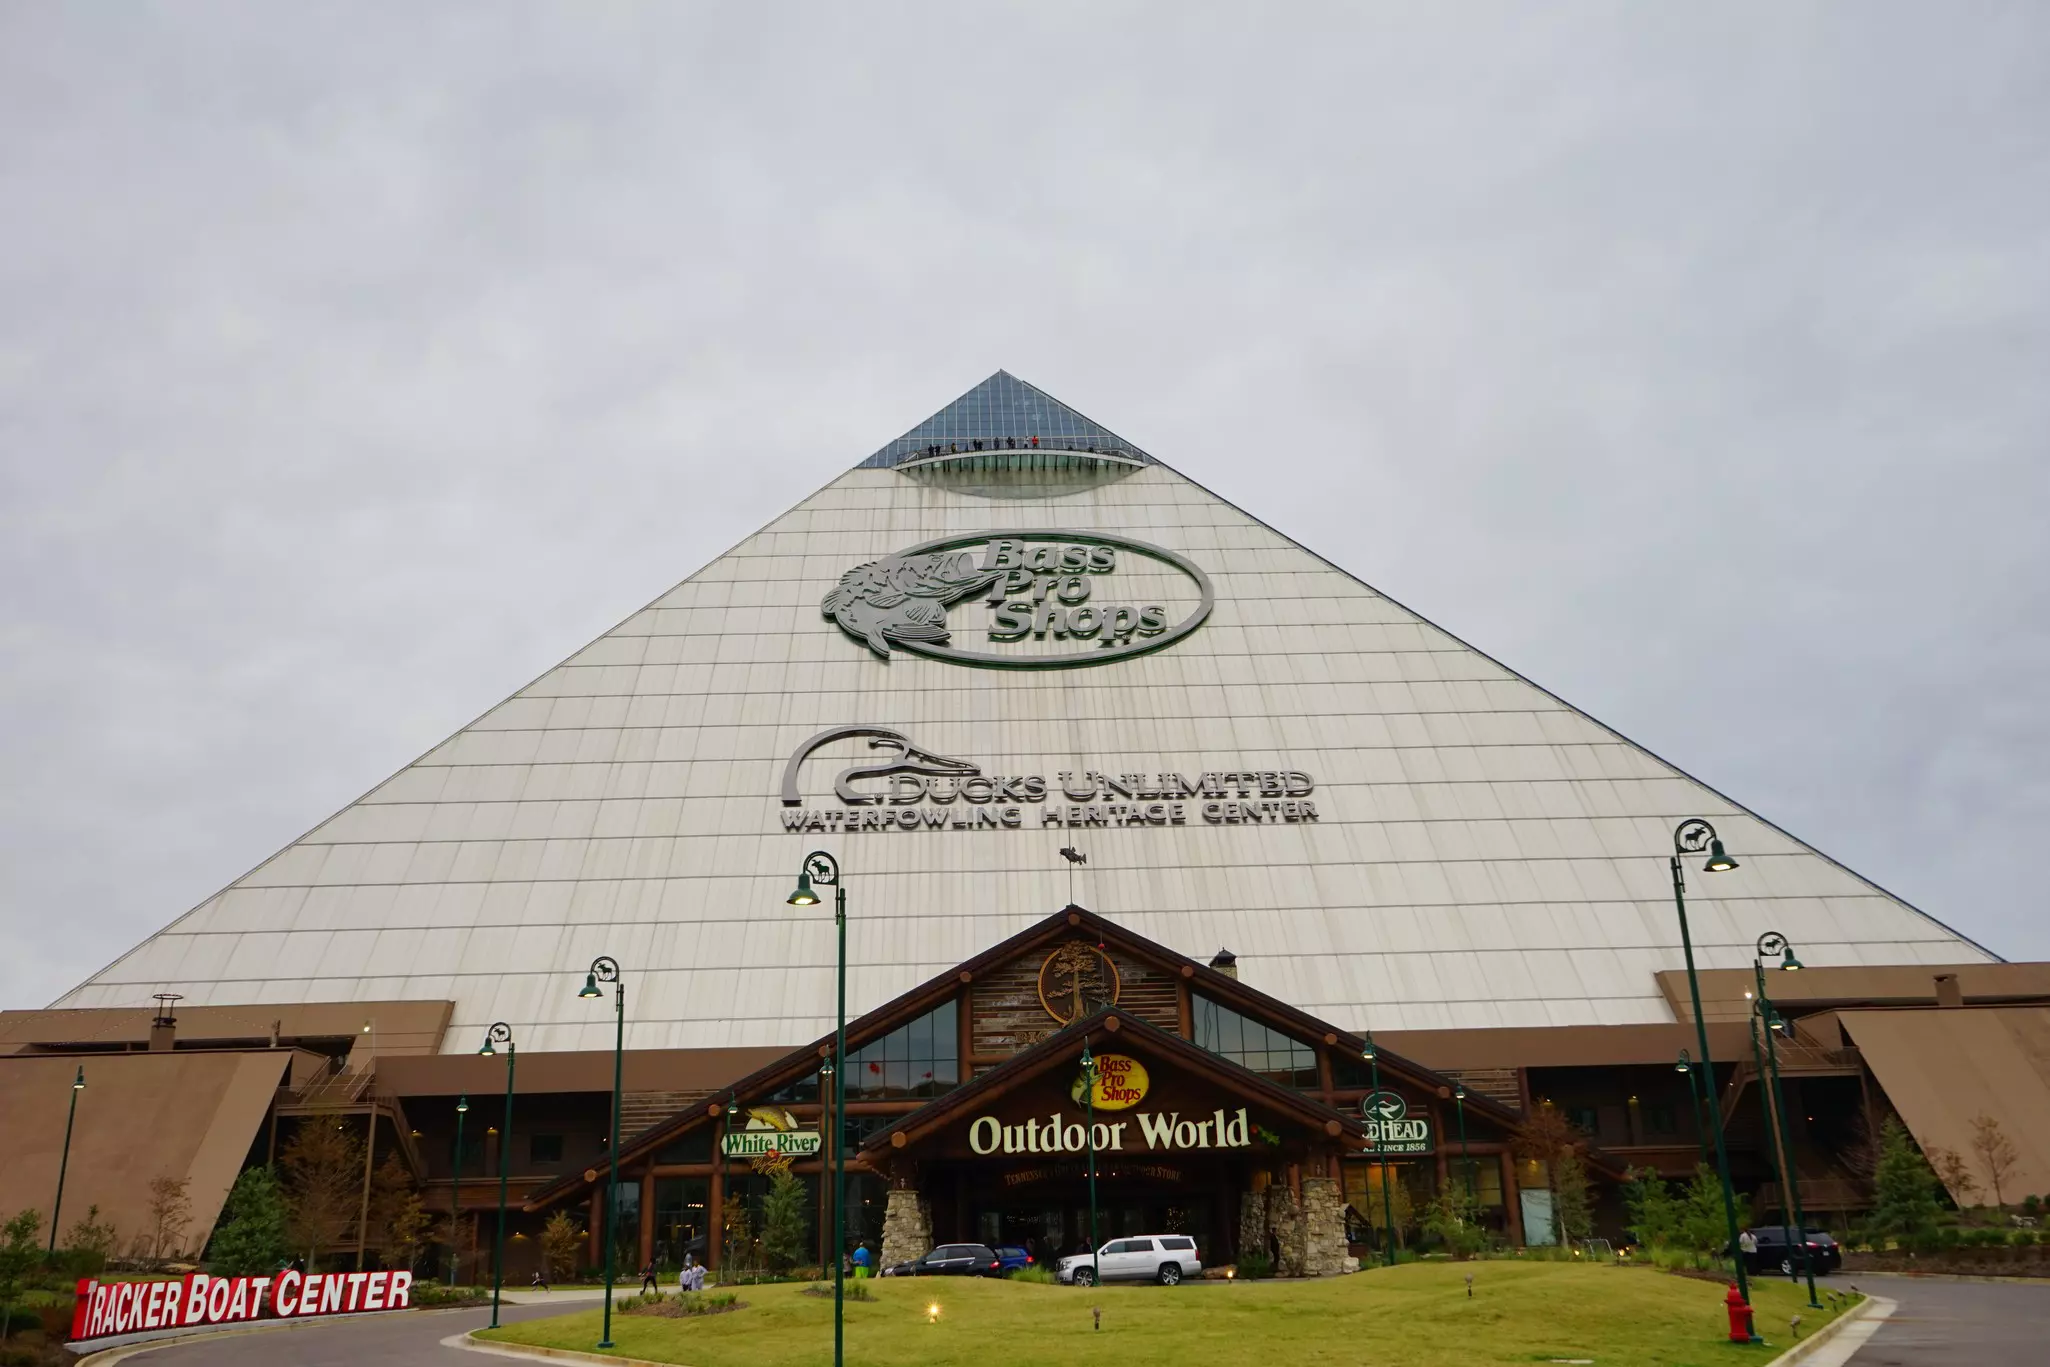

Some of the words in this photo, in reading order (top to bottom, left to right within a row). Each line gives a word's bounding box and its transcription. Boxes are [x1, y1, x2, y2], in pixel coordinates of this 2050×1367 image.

[977, 538, 1116, 573] Bass
[985, 570, 1092, 604] Pro
[987, 600, 1167, 642] Shops
[888, 772, 1048, 801] DUCKS
[1057, 769, 1316, 800] UNLIMITED
[780, 804, 1022, 832] WATERFOWLING
[1040, 803, 1186, 826] HERITAGE
[1201, 799, 1319, 824] CENTER
[1100, 1055, 1132, 1072] Bass
[1100, 1071, 1125, 1087] Pro
[1101, 1086, 1141, 1104] Shops
[726, 1134, 773, 1153] White
[776, 1133, 818, 1152] River
[968, 1112, 1127, 1155] Outdoor
[1135, 1107, 1251, 1150] World
[1406, 1143, 1426, 1151] 1856
[1157, 1166, 1182, 1183] STORE
[82, 1280, 182, 1338] TRACKER
[184, 1273, 271, 1323] BOAT
[274, 1269, 413, 1317] CENTER
